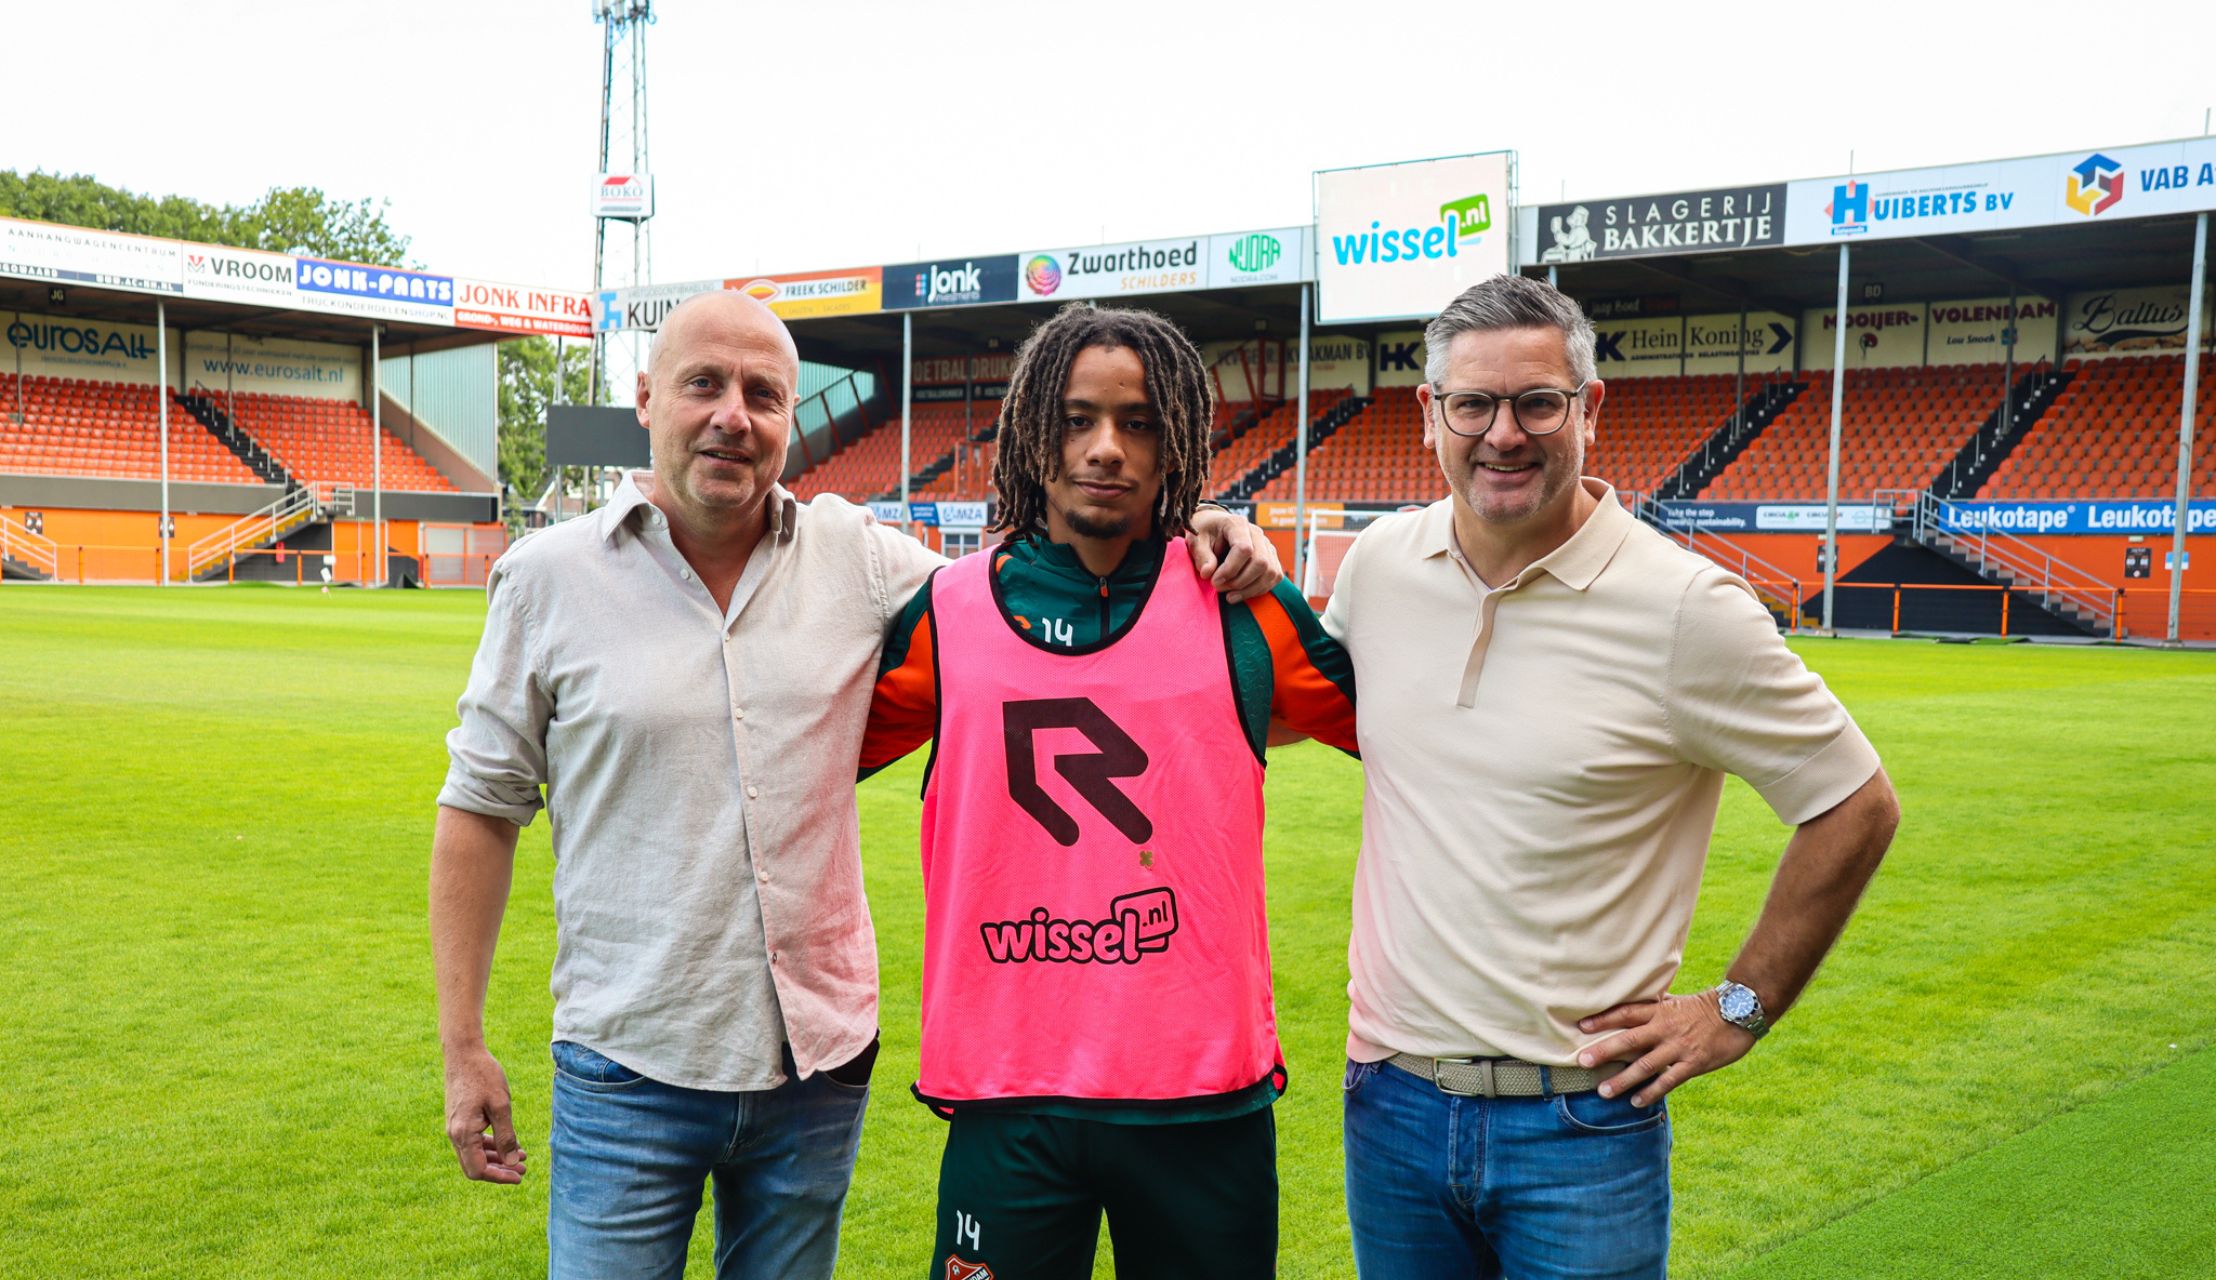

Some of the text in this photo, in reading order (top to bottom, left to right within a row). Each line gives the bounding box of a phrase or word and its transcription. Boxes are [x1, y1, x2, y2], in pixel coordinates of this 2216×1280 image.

[2141, 166, 2188, 192] VAB
[1605, 192, 1771, 226] SLAGERIJ
[1985, 192, 2014, 211] BV
[1332, 201, 1488, 266] wissel.nl
[1603, 216, 1772, 251] BAKKERTJE
[211, 257, 292, 284] VROOM
[1067, 241, 1198, 275] Zwarthoed
[299, 264, 451, 300] JONK-PARTS
[785, 279, 867, 297] FREEK SCHILDER
[928, 262, 981, 303] jonk
[1120, 271, 1197, 290] SCHILDERS
[459, 284, 592, 317] JONK INFRA
[1631, 324, 1765, 349] Hein Koning
[203, 359, 343, 383] www.eurosalt.nl
[1948, 506, 2069, 532] Leukotape
[1041, 618, 1073, 646] 14
[956, 1209, 981, 1251] 14
